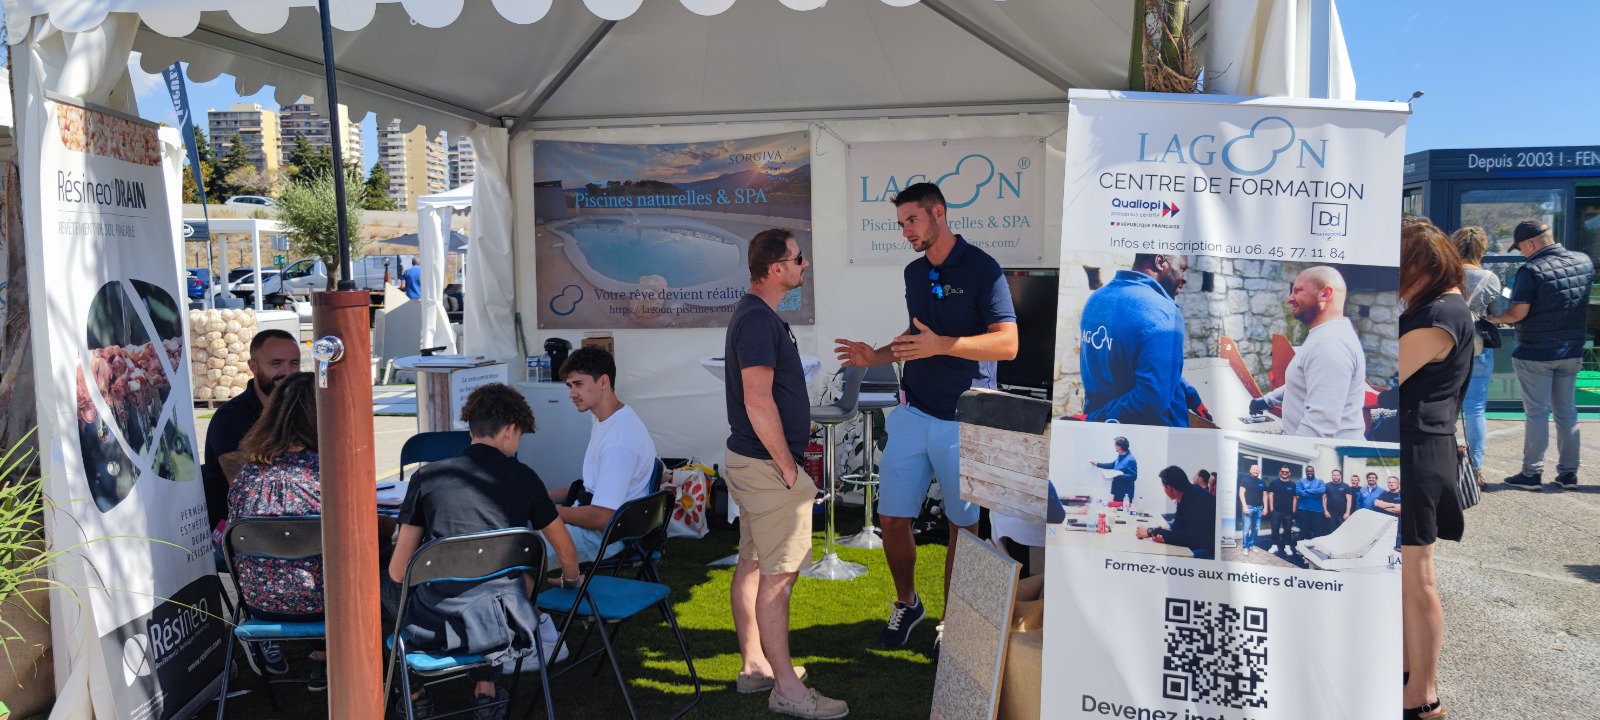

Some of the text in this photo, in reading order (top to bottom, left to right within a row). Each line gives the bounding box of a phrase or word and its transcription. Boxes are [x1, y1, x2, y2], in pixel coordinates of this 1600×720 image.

[728, 149, 782, 165] SORGIVA
[1468, 153, 1513, 172] Depuis
[1516, 151, 1554, 167] 2003
[57, 169, 147, 210] Résineo DRAIN
[1099, 171, 1364, 200] CENTRE DE FORMATION
[574, 187, 769, 209] Piscines naturelles & SPA
[1111, 197, 1161, 212] Qualiopi
[861, 214, 1032, 232] Piscin relles & SPA
[1109, 236, 1345, 260] Infos et inscription au 06. 45. 77. 11. 84
[594, 286, 747, 301] Votre rêve devient réalité
[1104, 558, 1345, 593] Formez-vous aux métiers d'avenir
[150, 597, 208, 661] Résineo
